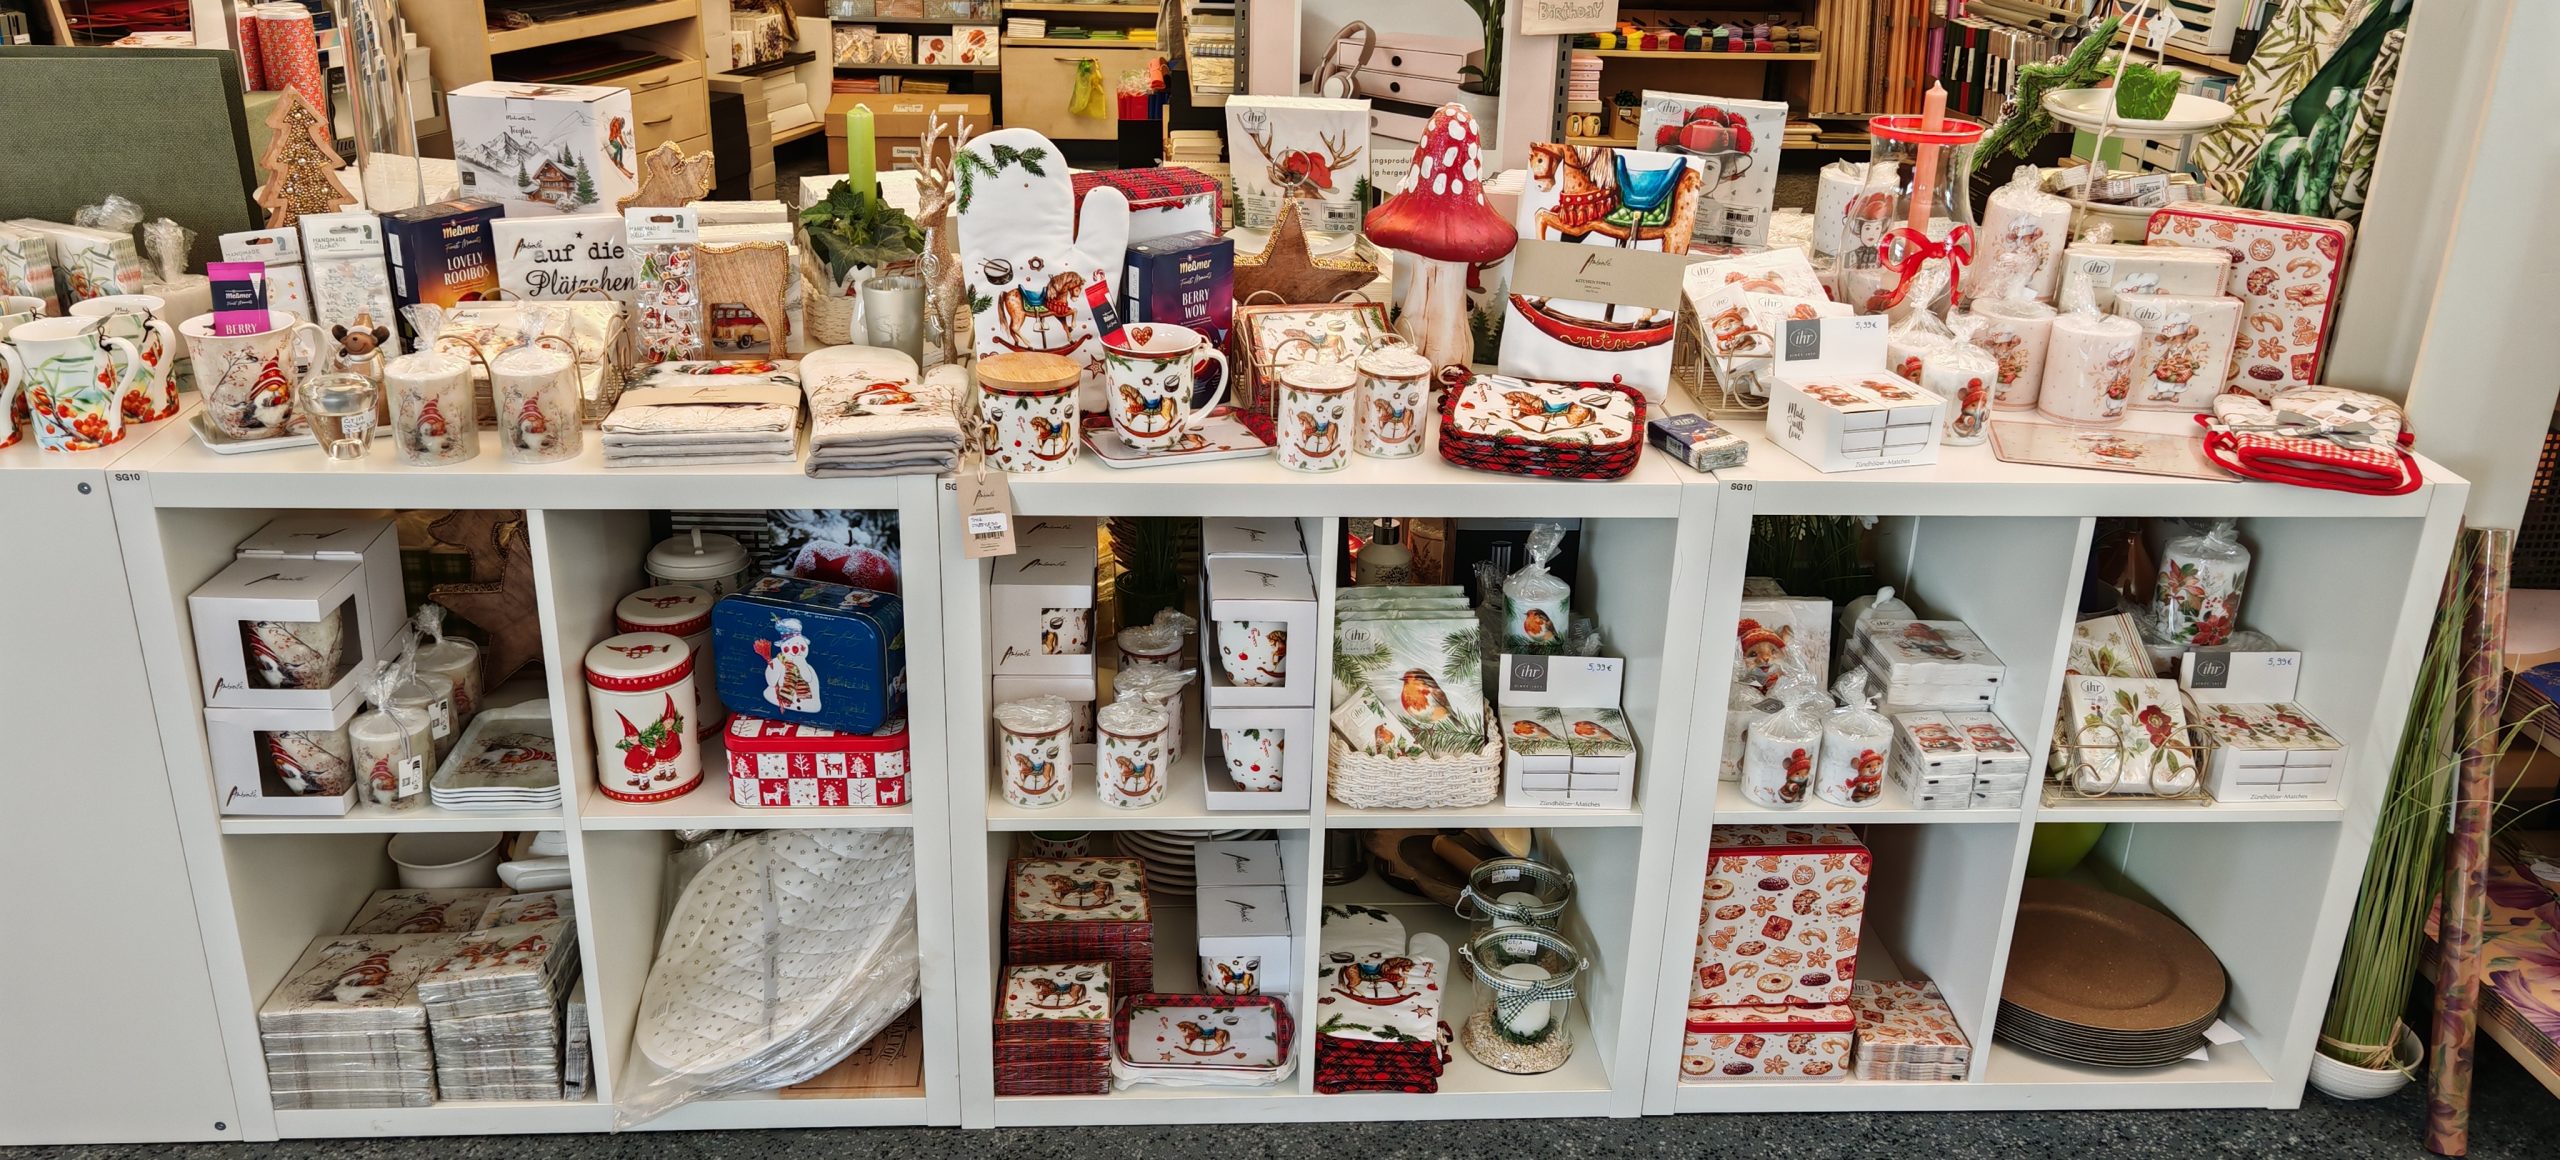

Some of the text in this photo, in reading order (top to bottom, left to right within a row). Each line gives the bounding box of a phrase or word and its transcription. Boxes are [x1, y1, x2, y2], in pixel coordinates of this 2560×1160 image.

[443, 224, 480, 239] Meßmer
[534, 241, 625, 263] auf die
[447, 251, 484, 271] LOVELY
[1180, 259, 1212, 273] Meßmer
[444, 264, 490, 286] ROOIBOS
[525, 266, 637, 297] Plätzchen
[225, 292, 252, 300] Meßmer
[1182, 288, 1210, 306] BERRY
[1184, 303, 1208, 319] WOW
[226, 322, 257, 336] BERRY
[1855, 321, 1878, 332] 5,99€
[1787, 402, 1808, 421] Made
[1791, 417, 1805, 434] with
[1788, 429, 1802, 441] love
[114, 473, 141, 481] SG10
[1730, 482, 1753, 491] SG10
[1587, 662, 1613, 673] 5,99€
[2267, 657, 2293, 667] 5,99€
